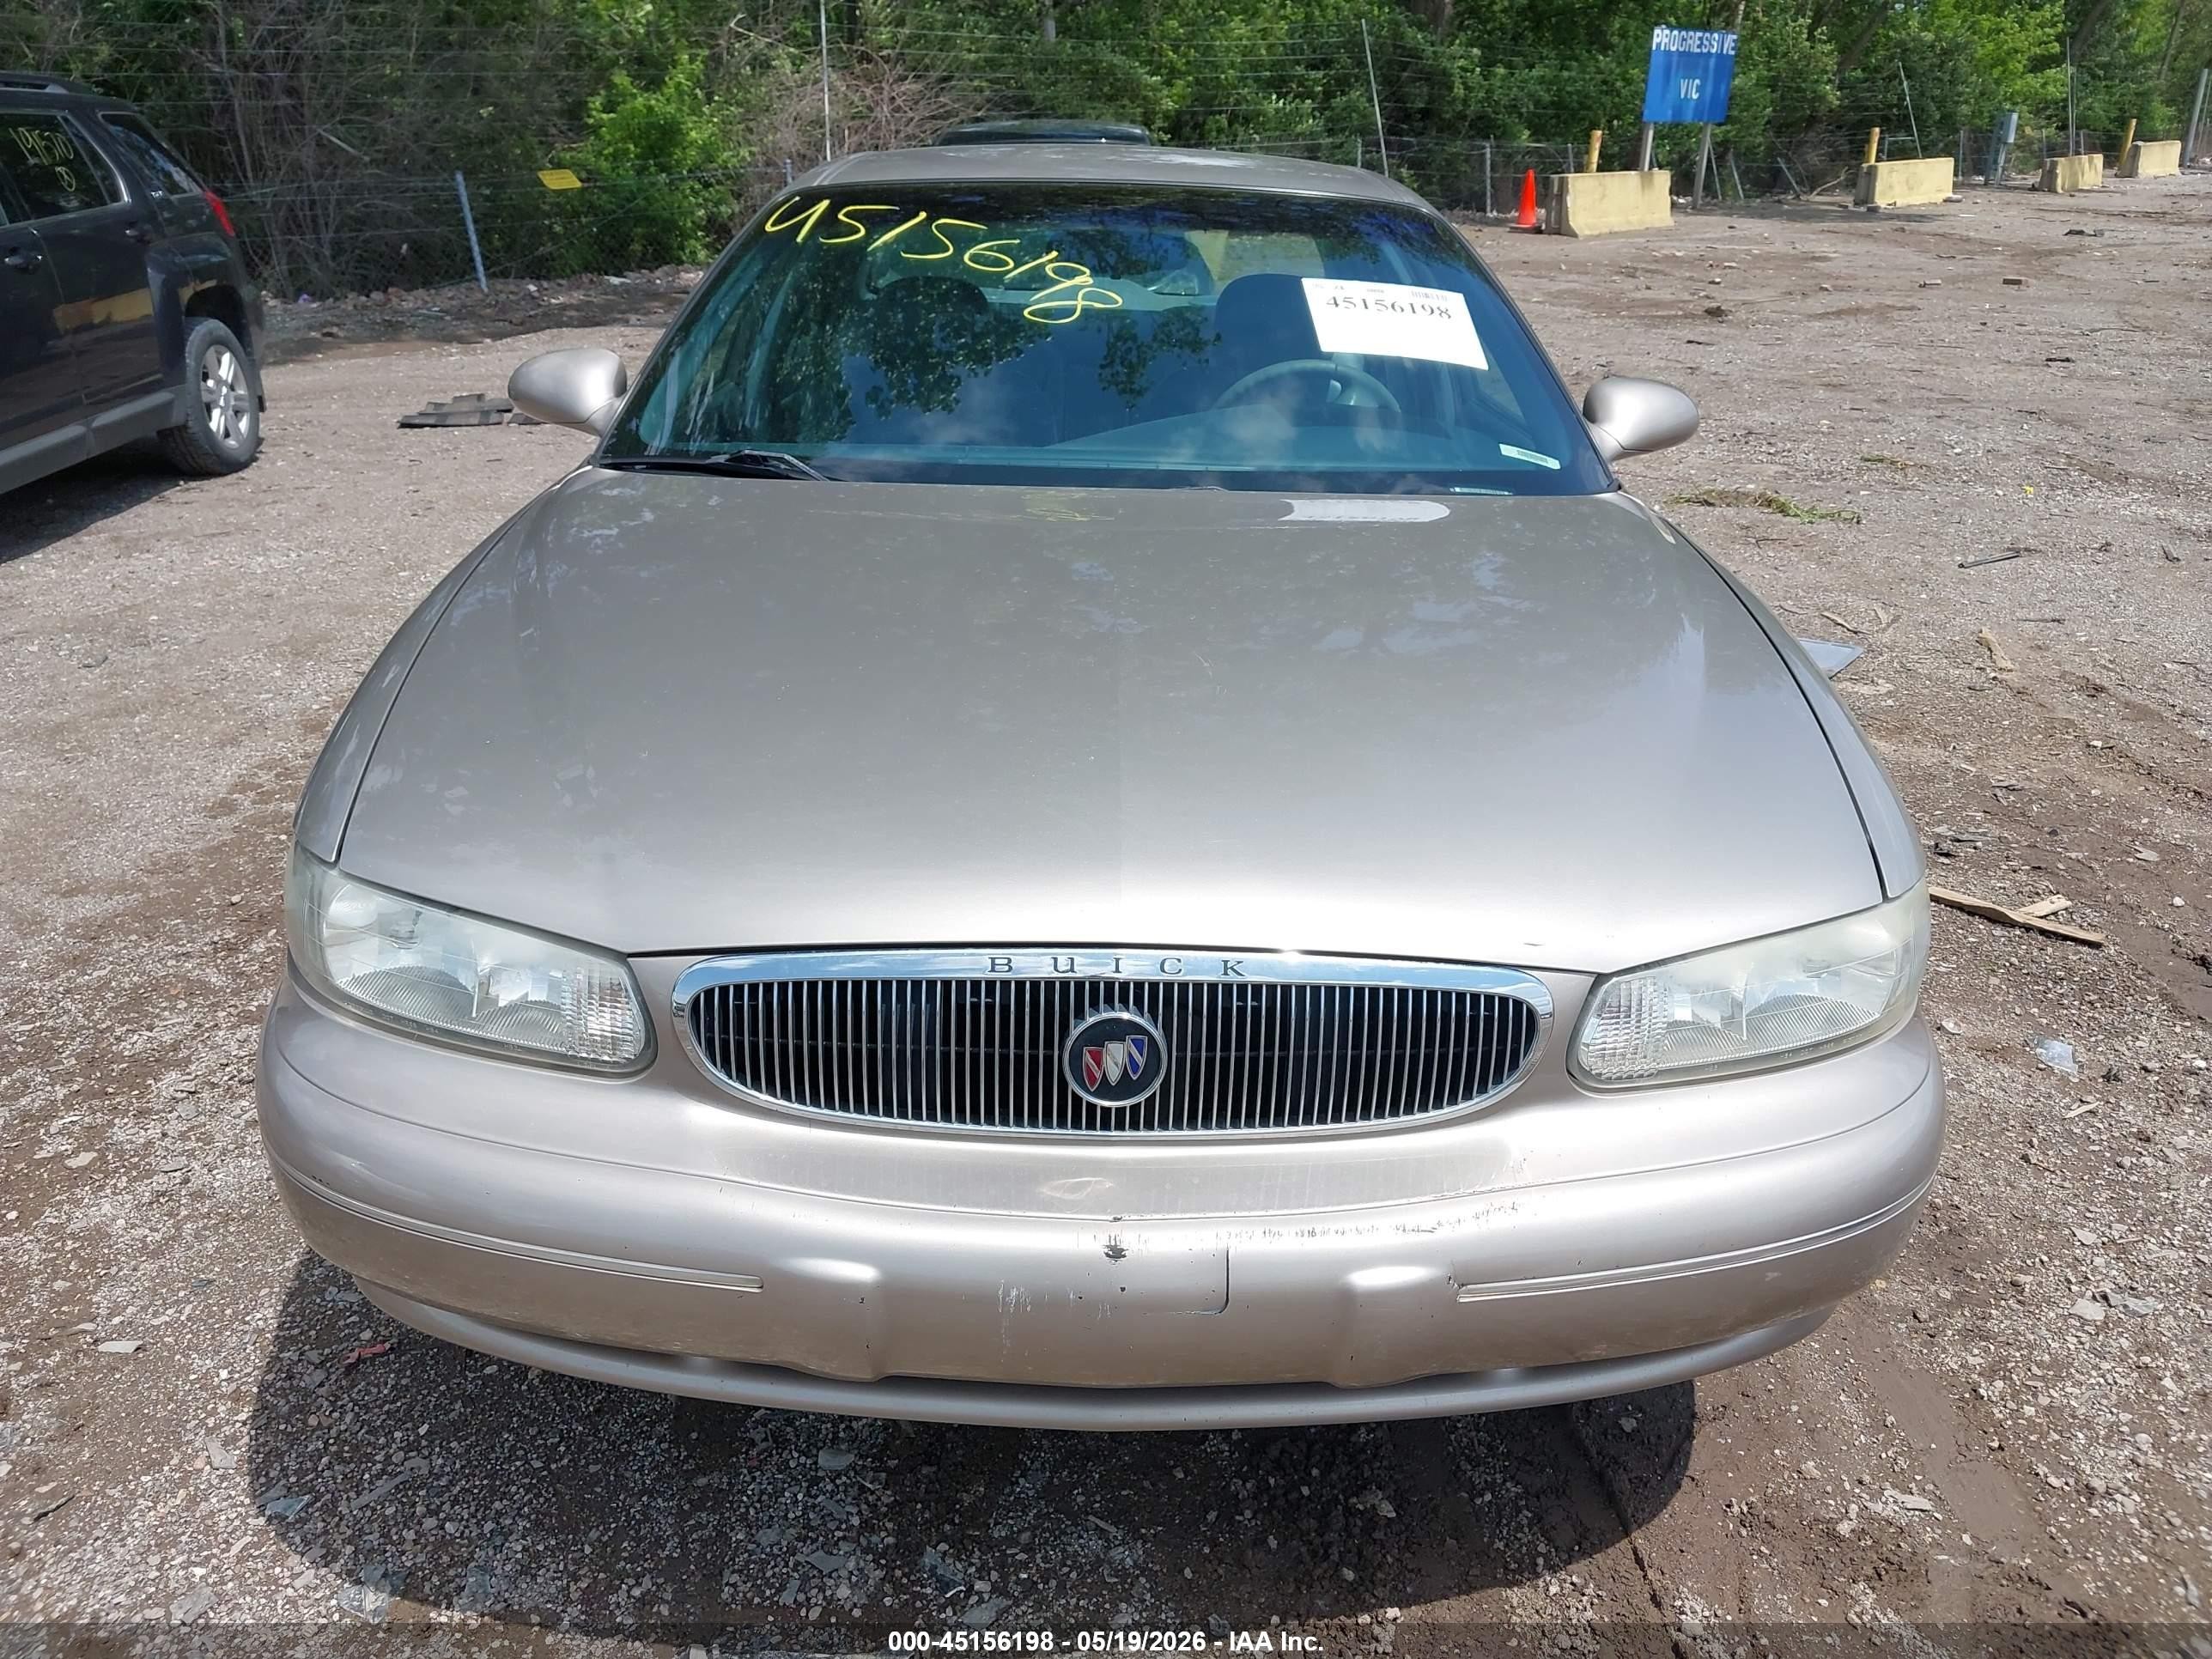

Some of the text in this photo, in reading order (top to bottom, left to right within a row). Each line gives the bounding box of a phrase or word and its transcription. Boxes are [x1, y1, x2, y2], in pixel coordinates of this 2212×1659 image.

[1652, 28, 1738, 56] PROGRESSIVE
[1680, 78, 1701, 100] VIC
[764, 196, 1123, 323] 45156198
[1326, 295, 1452, 319] 45156198
[987, 956, 1246, 977] BUICK
